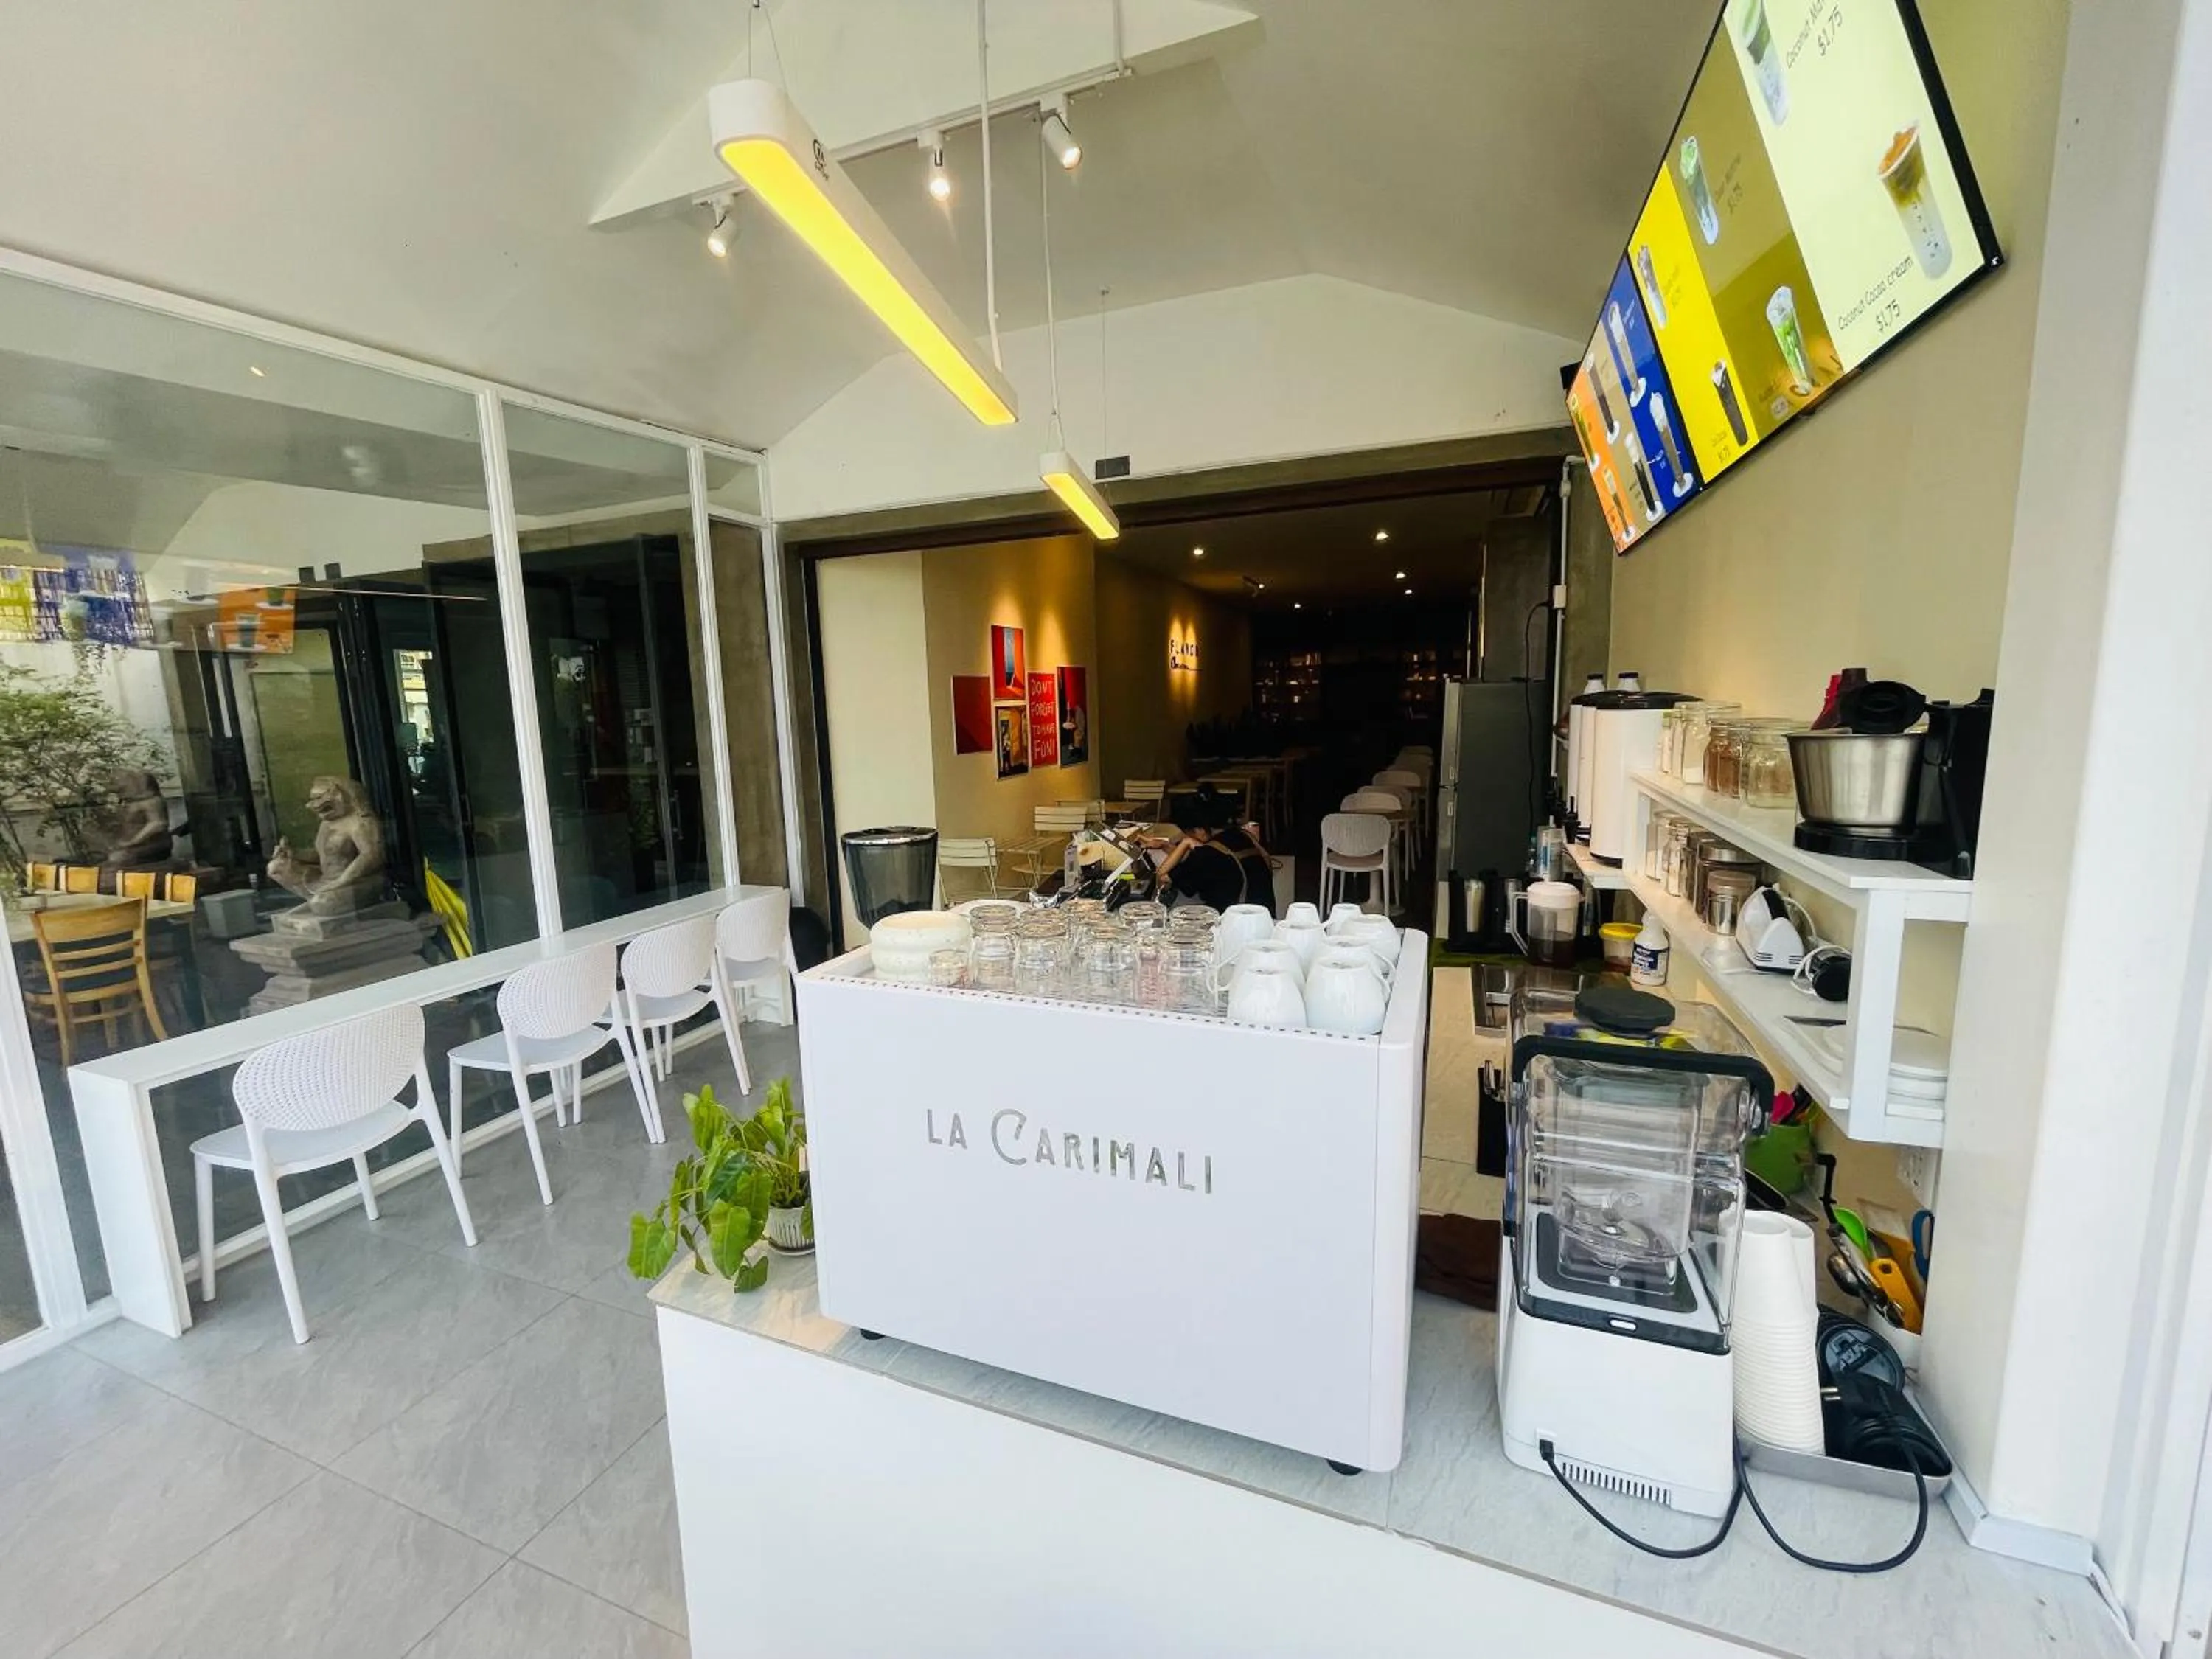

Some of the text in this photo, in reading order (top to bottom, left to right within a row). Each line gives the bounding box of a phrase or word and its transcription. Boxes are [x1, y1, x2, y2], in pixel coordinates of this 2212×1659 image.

[1838, 299, 1865, 330] Coconut
[1887, 255, 1914, 285] cream
[927, 1108, 1213, 1194] LA CARIMALI
